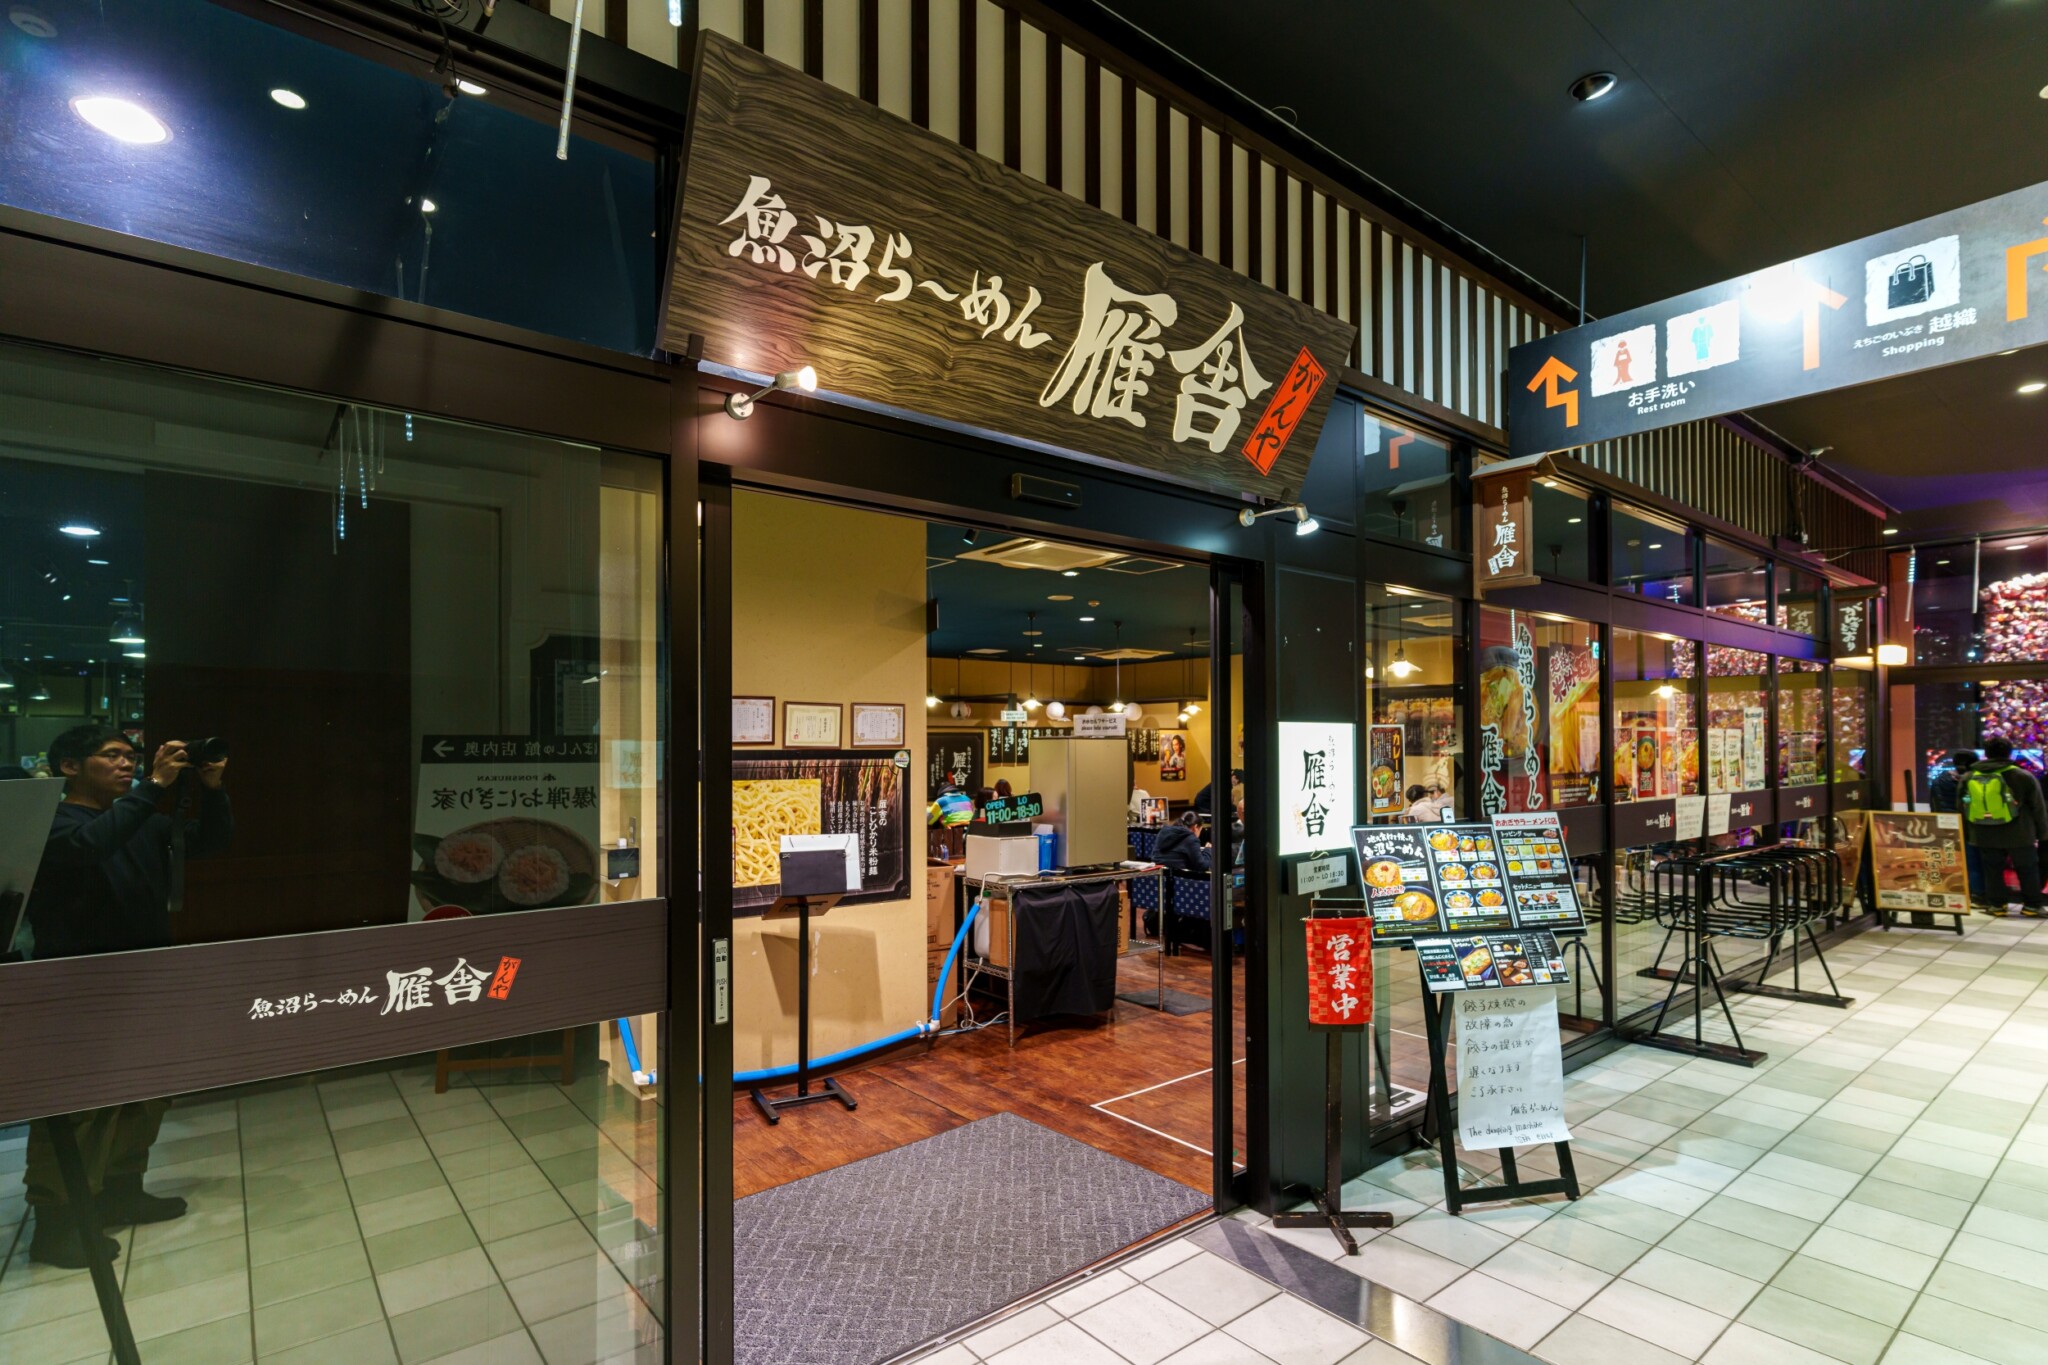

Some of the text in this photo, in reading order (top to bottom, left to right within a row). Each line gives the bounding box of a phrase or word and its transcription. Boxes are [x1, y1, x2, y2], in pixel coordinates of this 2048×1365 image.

[1039, 261, 1273, 453] 雁舎
[1882, 336, 1945, 357] Shopping
[1628, 380, 1696, 407] お手洗い
[1637, 398, 1686, 415] Rest room
[1255, 362, 1323, 458] がんや
[1494, 522, 1519, 568] 雁舎
[952, 751, 968, 786] 雁舎
[985, 796, 1027, 810] OPEN LO
[1301, 749, 1330, 838] 雁舎
[878, 800, 888, 826] 雁舎の
[380, 957, 493, 1015] 雁舎
[492, 958, 519, 998] がんや
[1326, 934, 1359, 1020] 営業中
[1465, 1016, 1514, 1031] 故障の為
[1469, 1061, 1522, 1079] 遅くなります
[1467, 1125, 1482, 1138] The
